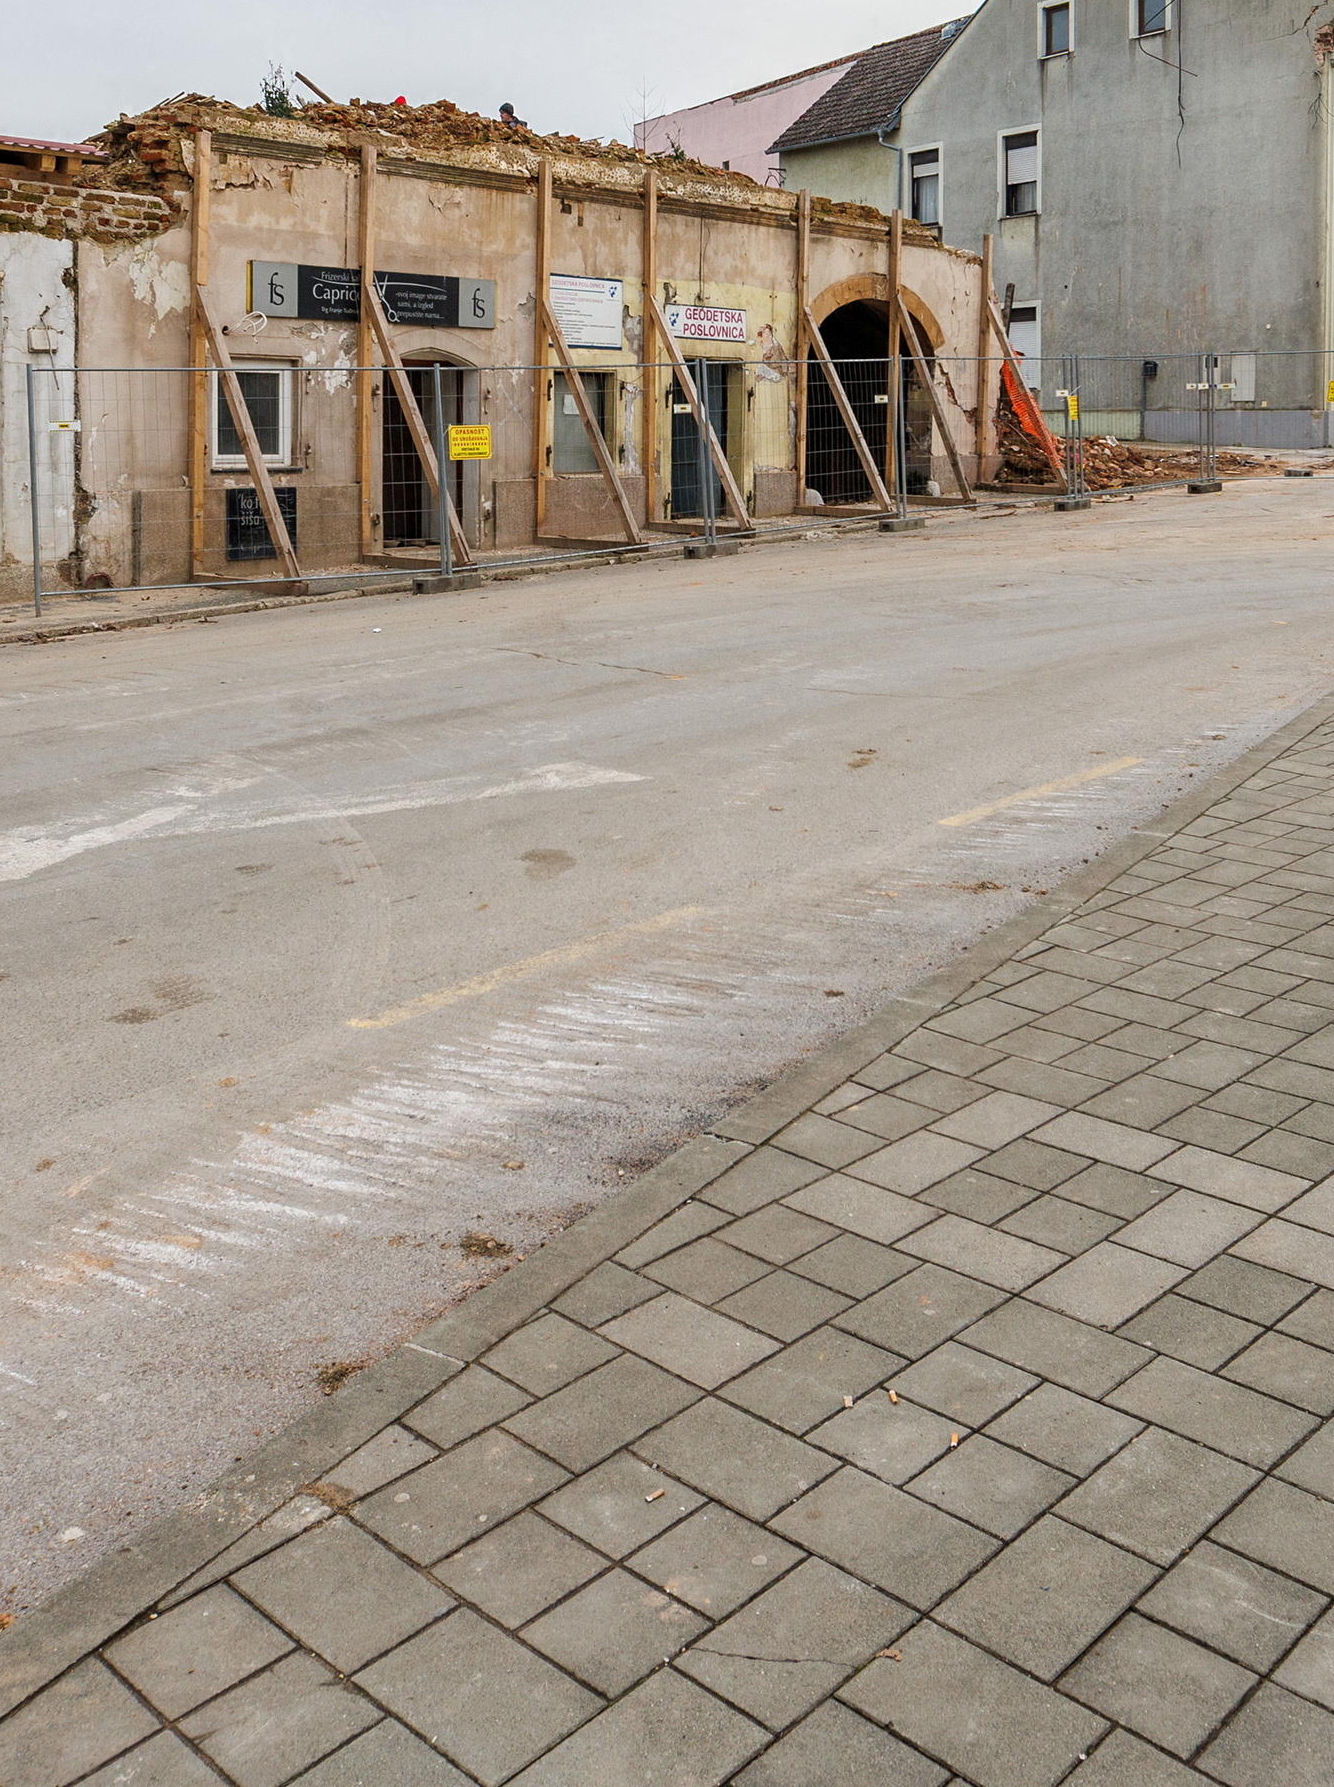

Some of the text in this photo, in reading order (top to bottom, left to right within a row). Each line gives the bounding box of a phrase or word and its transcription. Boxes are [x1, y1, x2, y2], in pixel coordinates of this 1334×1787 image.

[321, 271, 350, 283] Frizerski
[685, 308, 743, 324] GEODETSKA
[683, 323, 744, 339] POSLOVNICA
